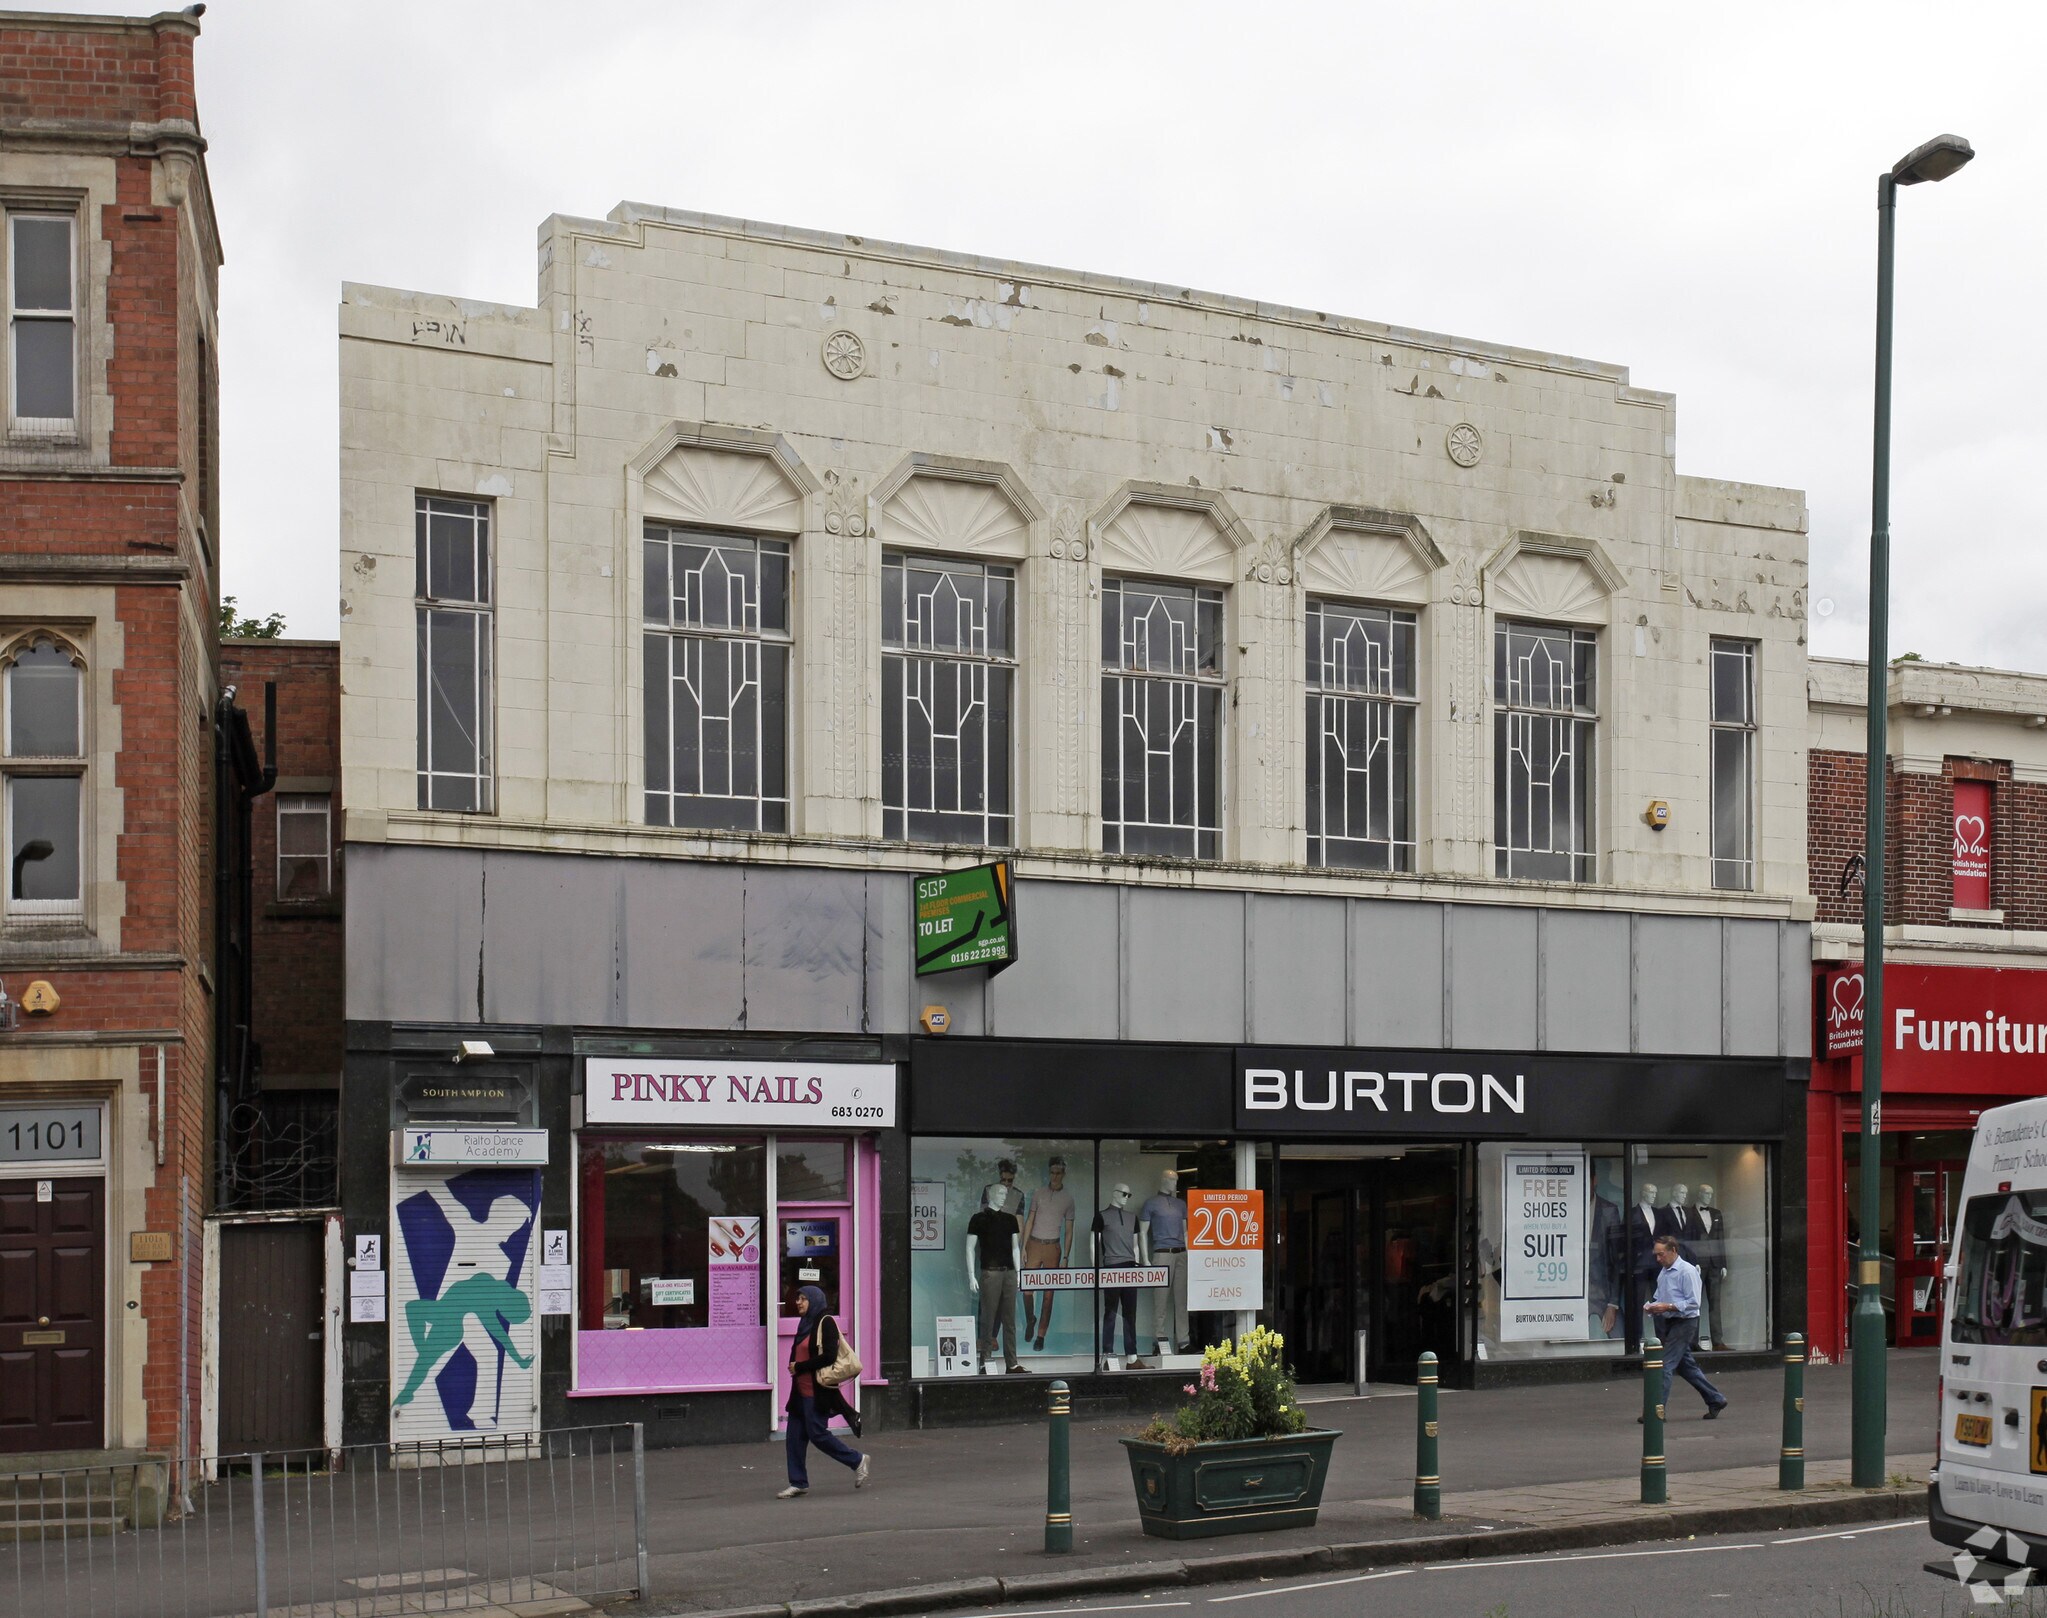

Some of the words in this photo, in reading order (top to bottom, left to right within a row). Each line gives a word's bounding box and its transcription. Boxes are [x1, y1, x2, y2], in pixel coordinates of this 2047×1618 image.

[920, 880, 947, 898] SGP
[930, 899, 948, 910] FLOOR
[950, 890, 988, 906] COMMERCIAL
[920, 906, 950, 918] PREMISES
[919, 922, 932, 936] TO
[936, 918, 954, 934] LET
[978, 935, 1006, 947] sgp.co.uk
[951, 952, 969, 963] 0116
[970, 950, 980, 960] 22
[981, 948, 990, 958] 22
[992, 946, 1006, 956] 999
[1829, 1030, 1850, 1040] British
[611, 1073, 716, 1102] PINKY
[727, 1076, 823, 1104] NAILS
[1245, 1069, 1524, 1114] BURTON
[831, 1106, 852, 1118] 683
[856, 1106, 884, 1118] 0270
[8, 1120, 82, 1150] 1101
[464, 1135, 491, 1146] Rialto
[493, 1135, 524, 1146] Dance
[1994, 1121, 2040, 1145] Bernadette's
[466, 1146, 521, 1158] Academy
[1519, 1166, 1538, 1174] LIMITED
[1540, 1166, 1558, 1174] PERIOD
[1992, 1152, 2022, 1174] Primary
[1524, 1179, 1568, 1198] FREE
[914, 1206, 937, 1218] FOR
[1524, 1202, 1567, 1218] SHOES
[1240, 1234, 1258, 1246] OFF
[1524, 1234, 1568, 1258] SUIT
[1204, 1256, 1246, 1268] CHINOS
[1024, 1272, 1072, 1286] TAILORED
[1075, 1272, 1095, 1284] FOR
[1100, 1271, 1144, 1284] FATHERS
[1147, 1270, 1166, 1282] DAY
[1537, 1262, 1568, 1282] £99
[1208, 1286, 1242, 1298] JEANS
[1516, 1314, 1574, 1323] BURTON.CO.UK/SUITING
